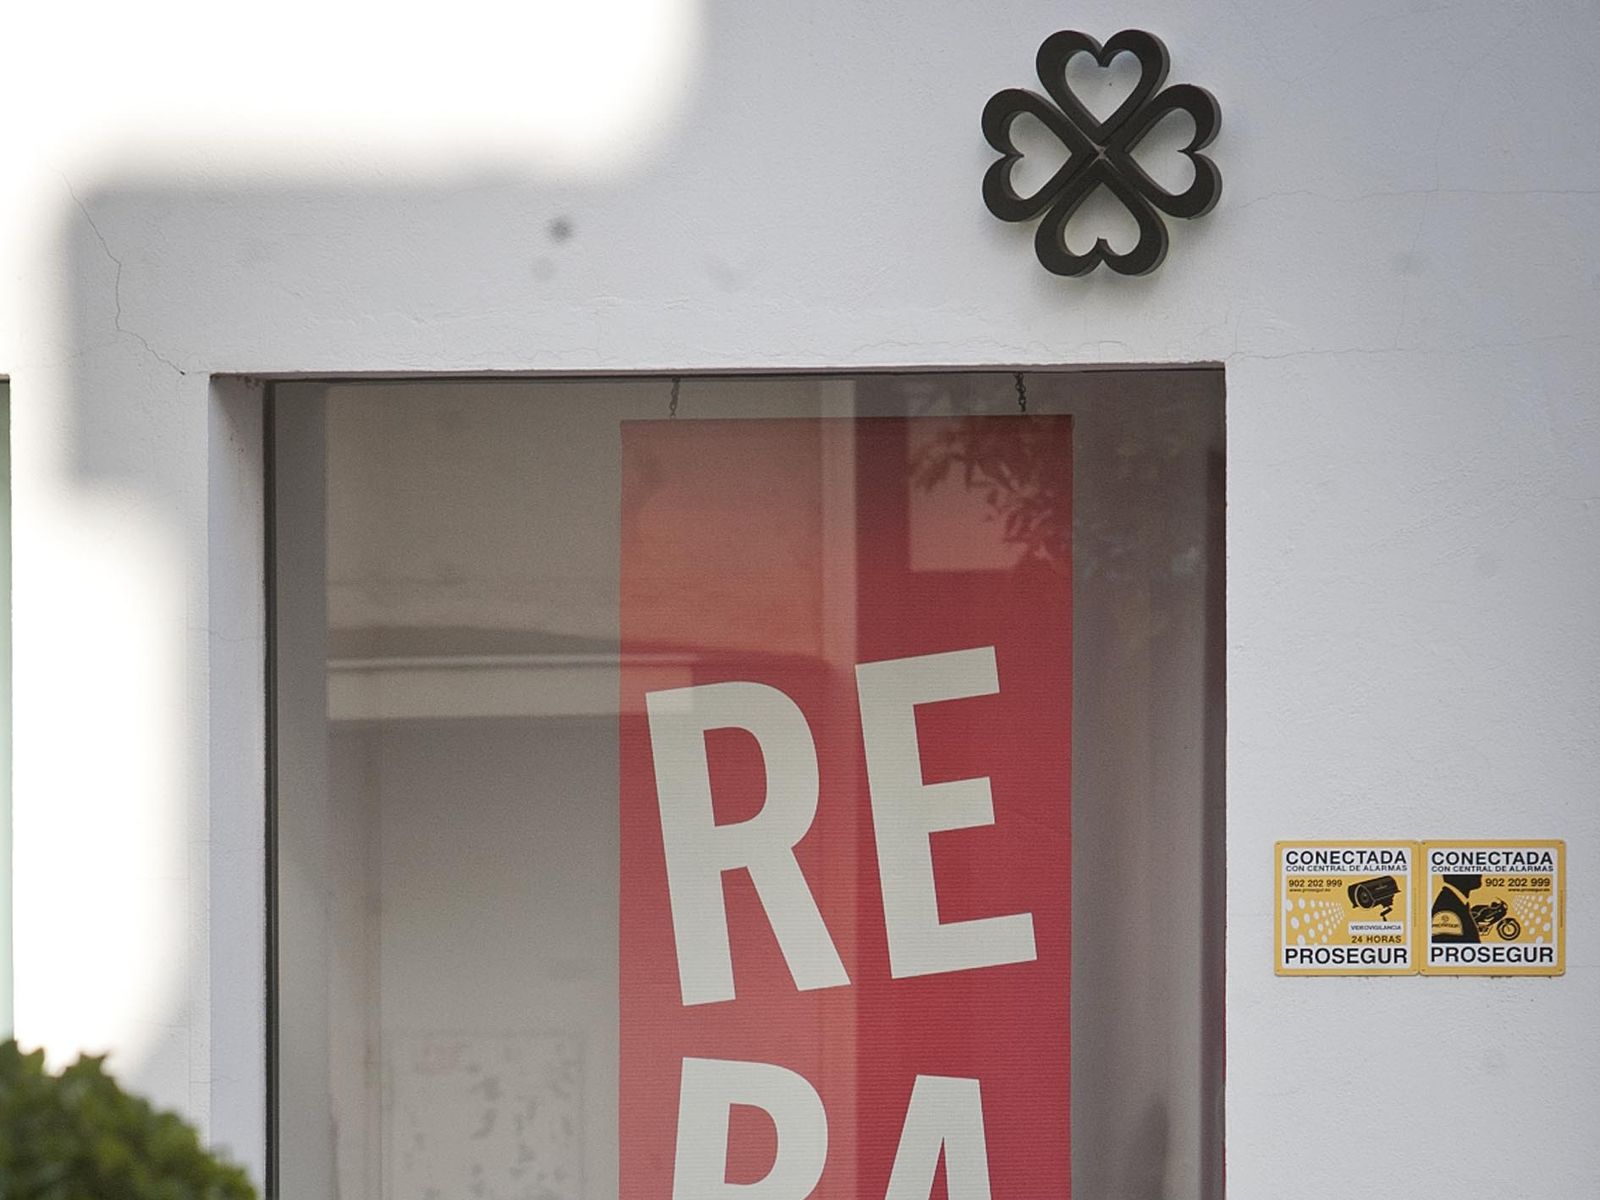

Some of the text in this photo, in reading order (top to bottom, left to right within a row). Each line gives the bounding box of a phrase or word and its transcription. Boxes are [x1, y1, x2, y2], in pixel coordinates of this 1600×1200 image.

[645, 646, 1038, 1006] RE
[1285, 850, 1407, 865] CONECTADA
[1431, 851, 1554, 865] CONECTADA
[1288, 879, 1343, 887] 902 202 999
[1485, 878, 1550, 887] 902 202 999
[1351, 935, 1402, 943] 24 HORAS
[1285, 948, 1408, 964] PROSEGUR
[1431, 947, 1554, 963] PROSEGUR
